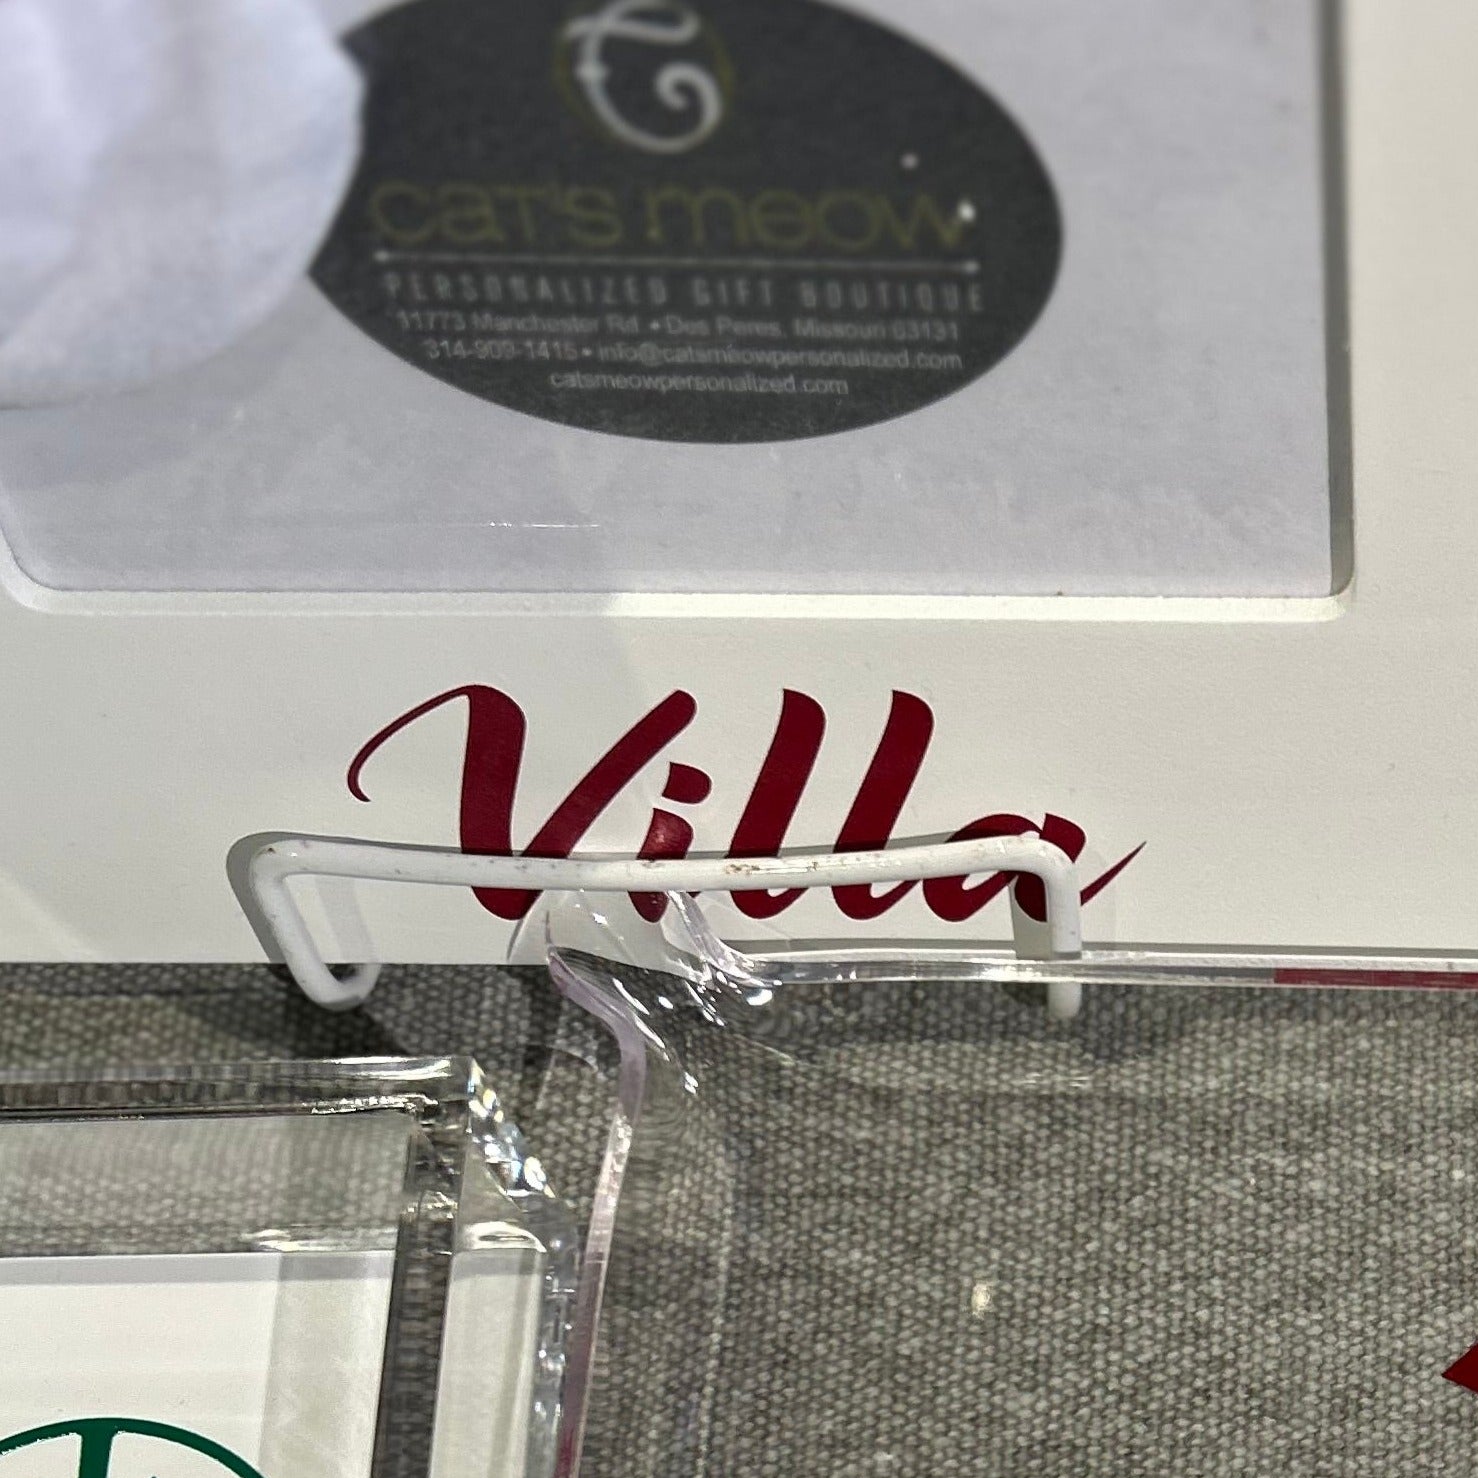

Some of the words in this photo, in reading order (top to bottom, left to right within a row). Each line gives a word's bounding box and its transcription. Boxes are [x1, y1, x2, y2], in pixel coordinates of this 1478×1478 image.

[385, 272, 668, 304] PERSONALIZED
[692, 277, 773, 308] GIFT
[801, 280, 983, 312] BOUTIQUE
[471, 312, 599, 333] Manchester
[550, 370, 849, 396] catsmeowpersonalized.com
[347, 684, 1147, 922] Villa
